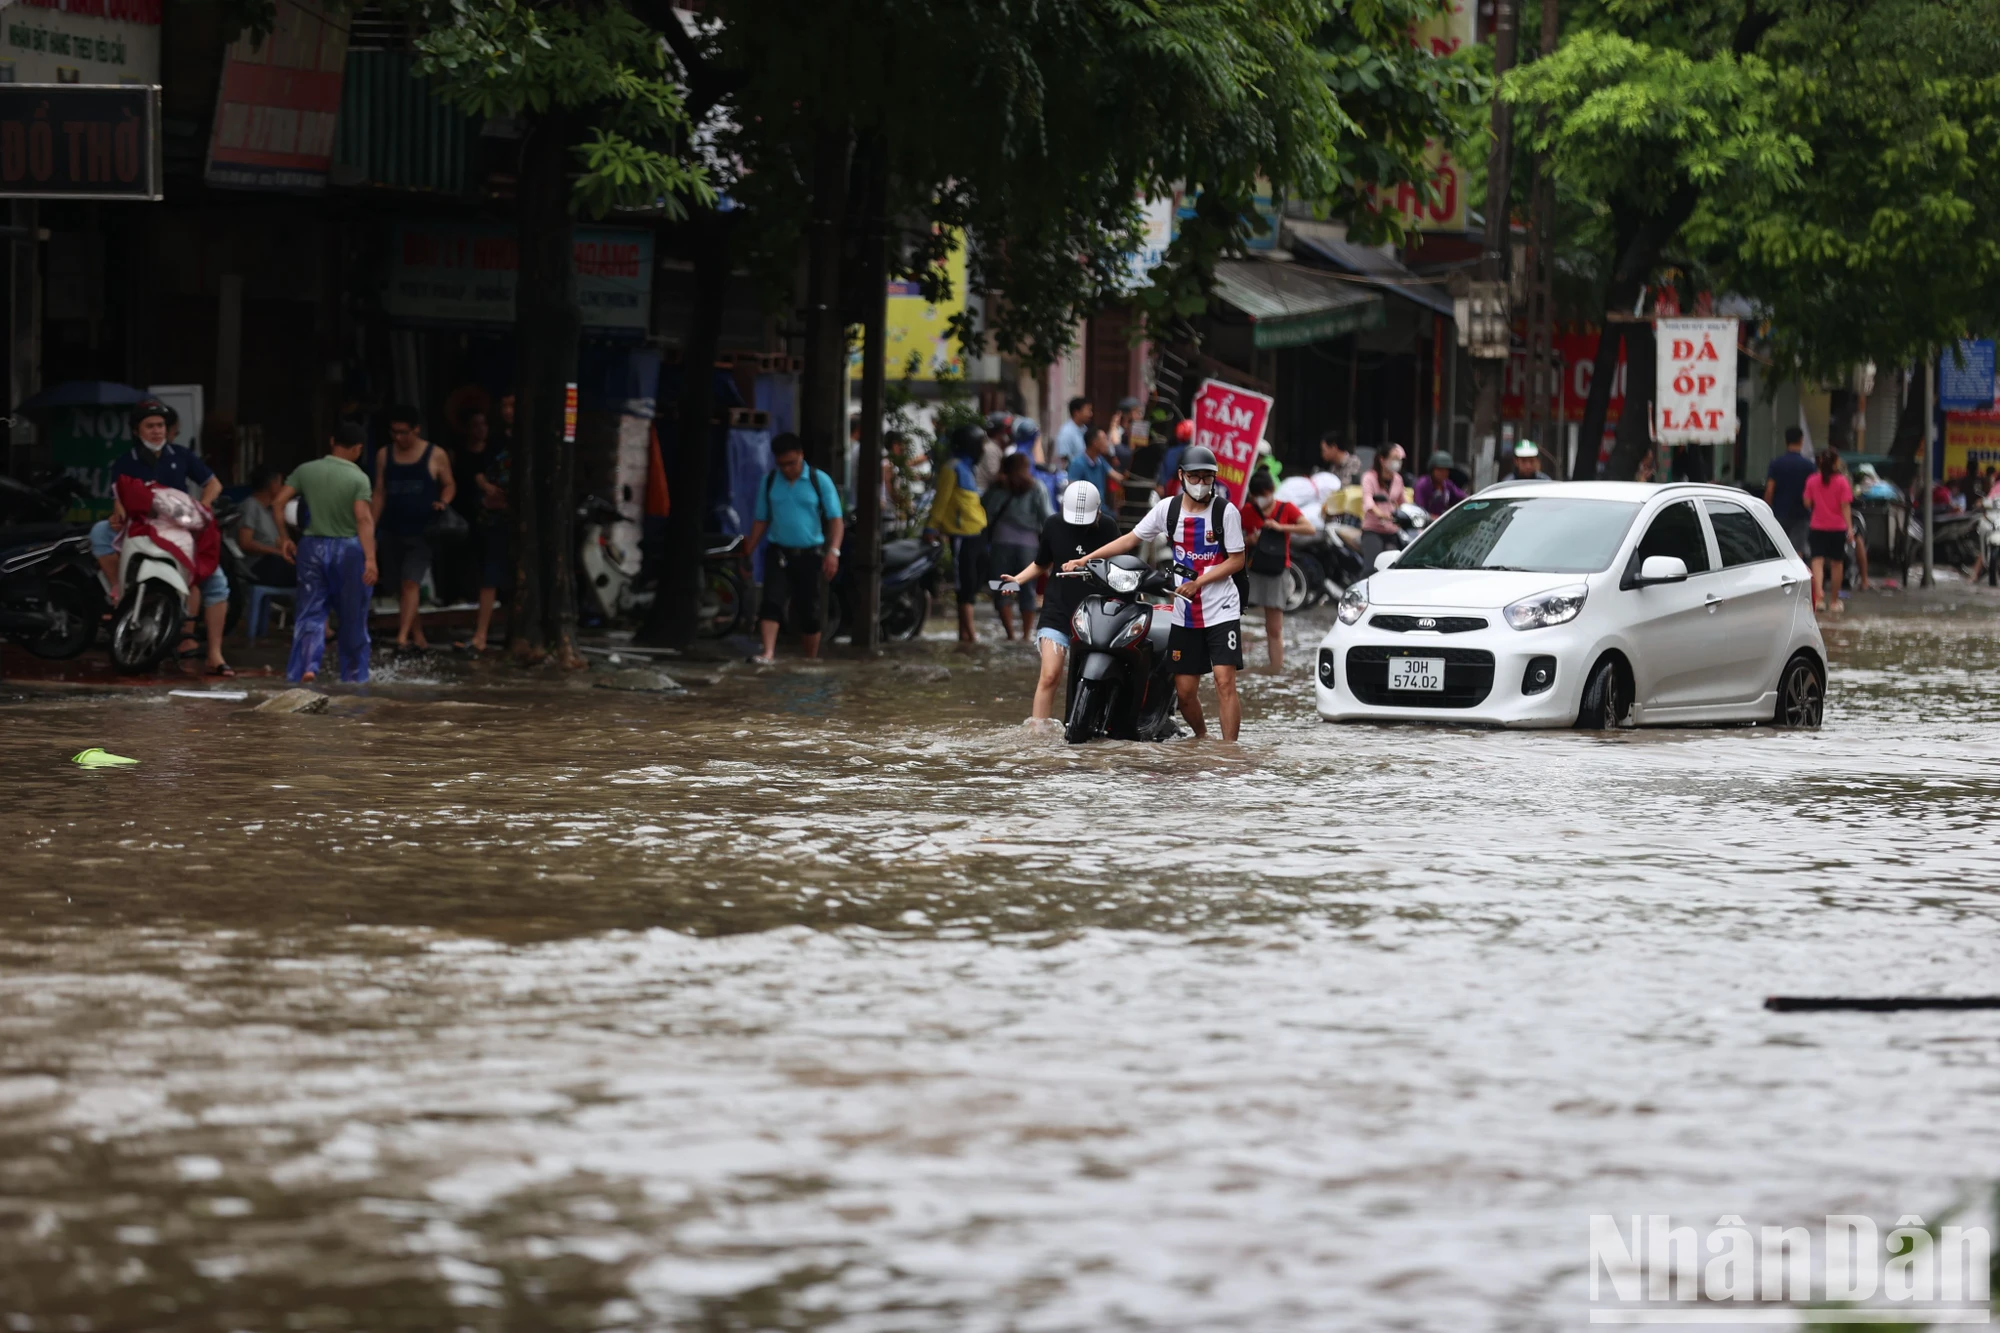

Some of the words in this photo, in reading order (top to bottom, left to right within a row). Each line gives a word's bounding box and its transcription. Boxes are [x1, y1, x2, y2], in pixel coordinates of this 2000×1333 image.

[62, 105, 141, 183] THỜ
[1203, 393, 1254, 431] TẨM
[1186, 550, 1216, 562] Spotify
[1418, 619, 1433, 628] KIA
[1227, 630, 1237, 651] 8
[1405, 661, 1428, 673] 30H
[1394, 675, 1437, 689] 574.02
